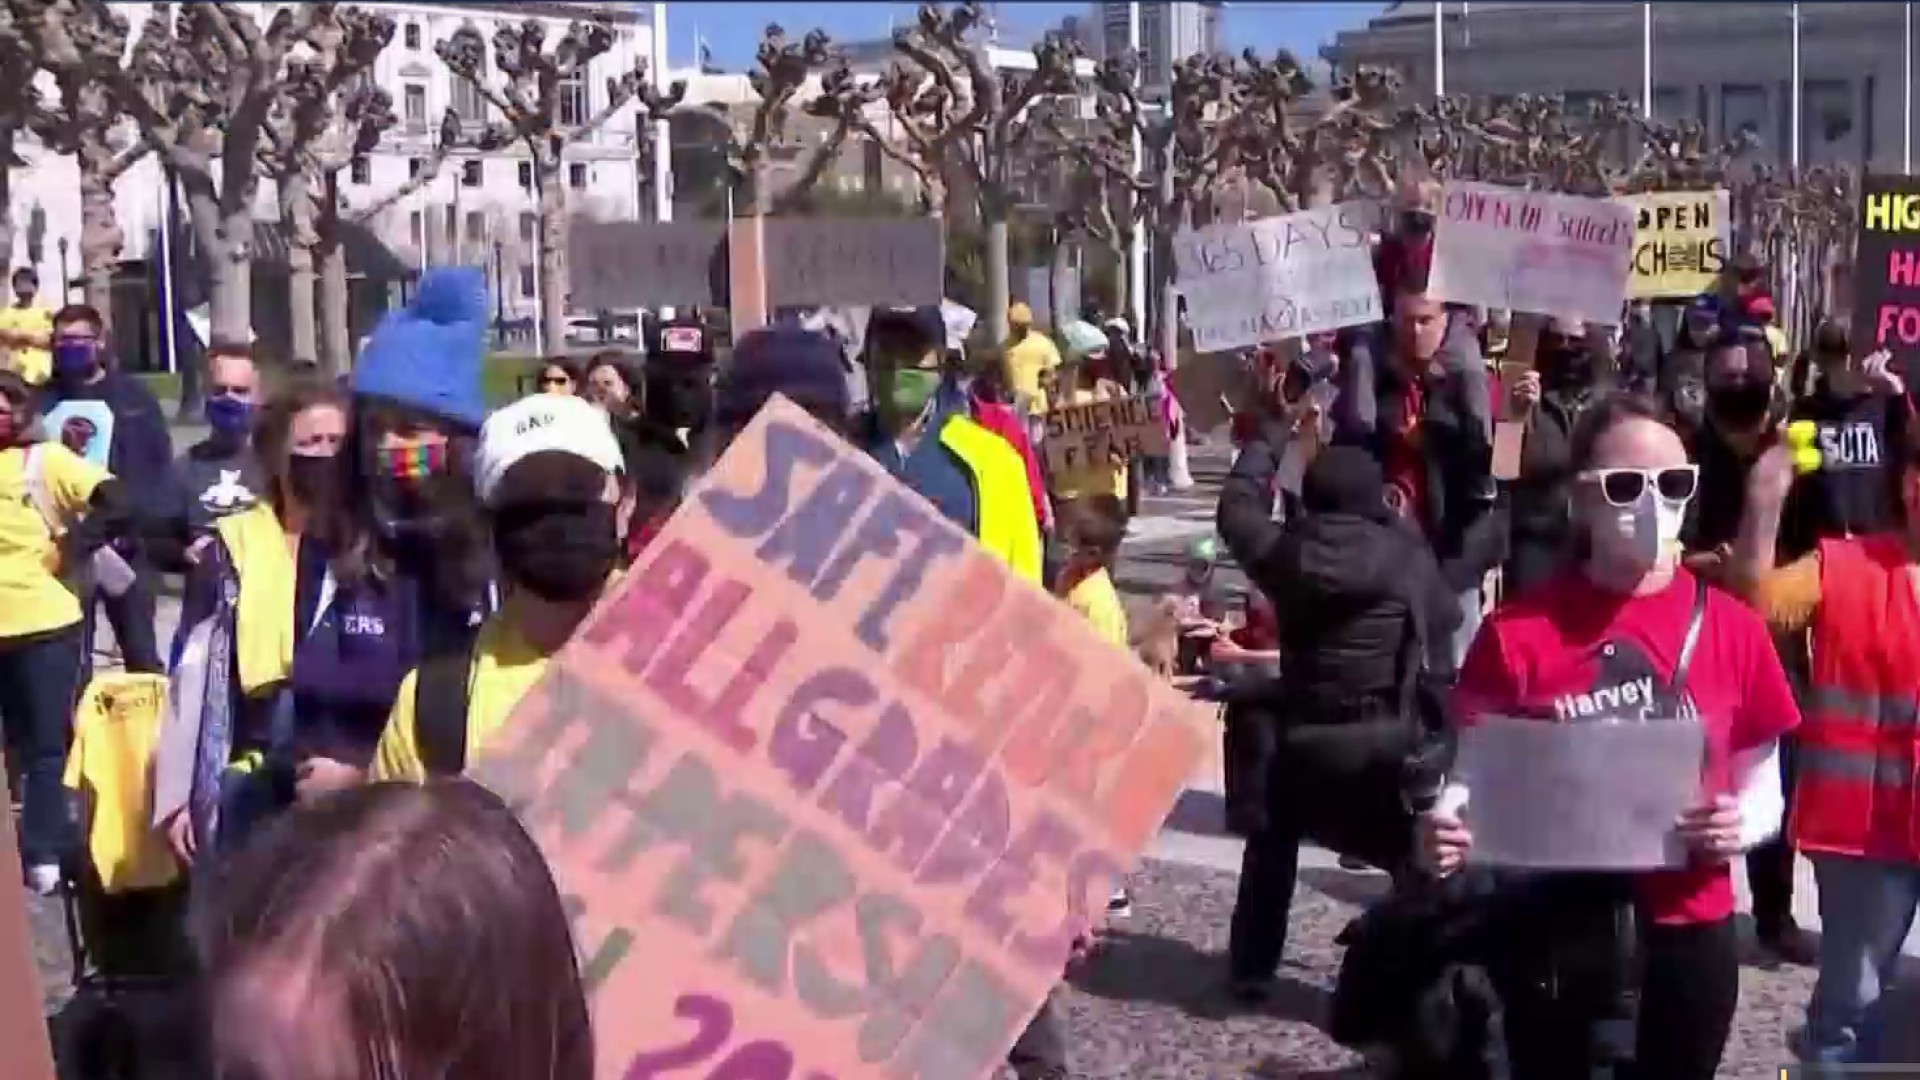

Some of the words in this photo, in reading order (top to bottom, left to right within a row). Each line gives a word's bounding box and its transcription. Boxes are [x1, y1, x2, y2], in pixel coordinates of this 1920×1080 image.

[700, 420, 965, 652] SAFE
[583, 538, 800, 750] ALL
[767, 667, 1124, 970] GRADES
[1554, 676, 1655, 722] Harvey
